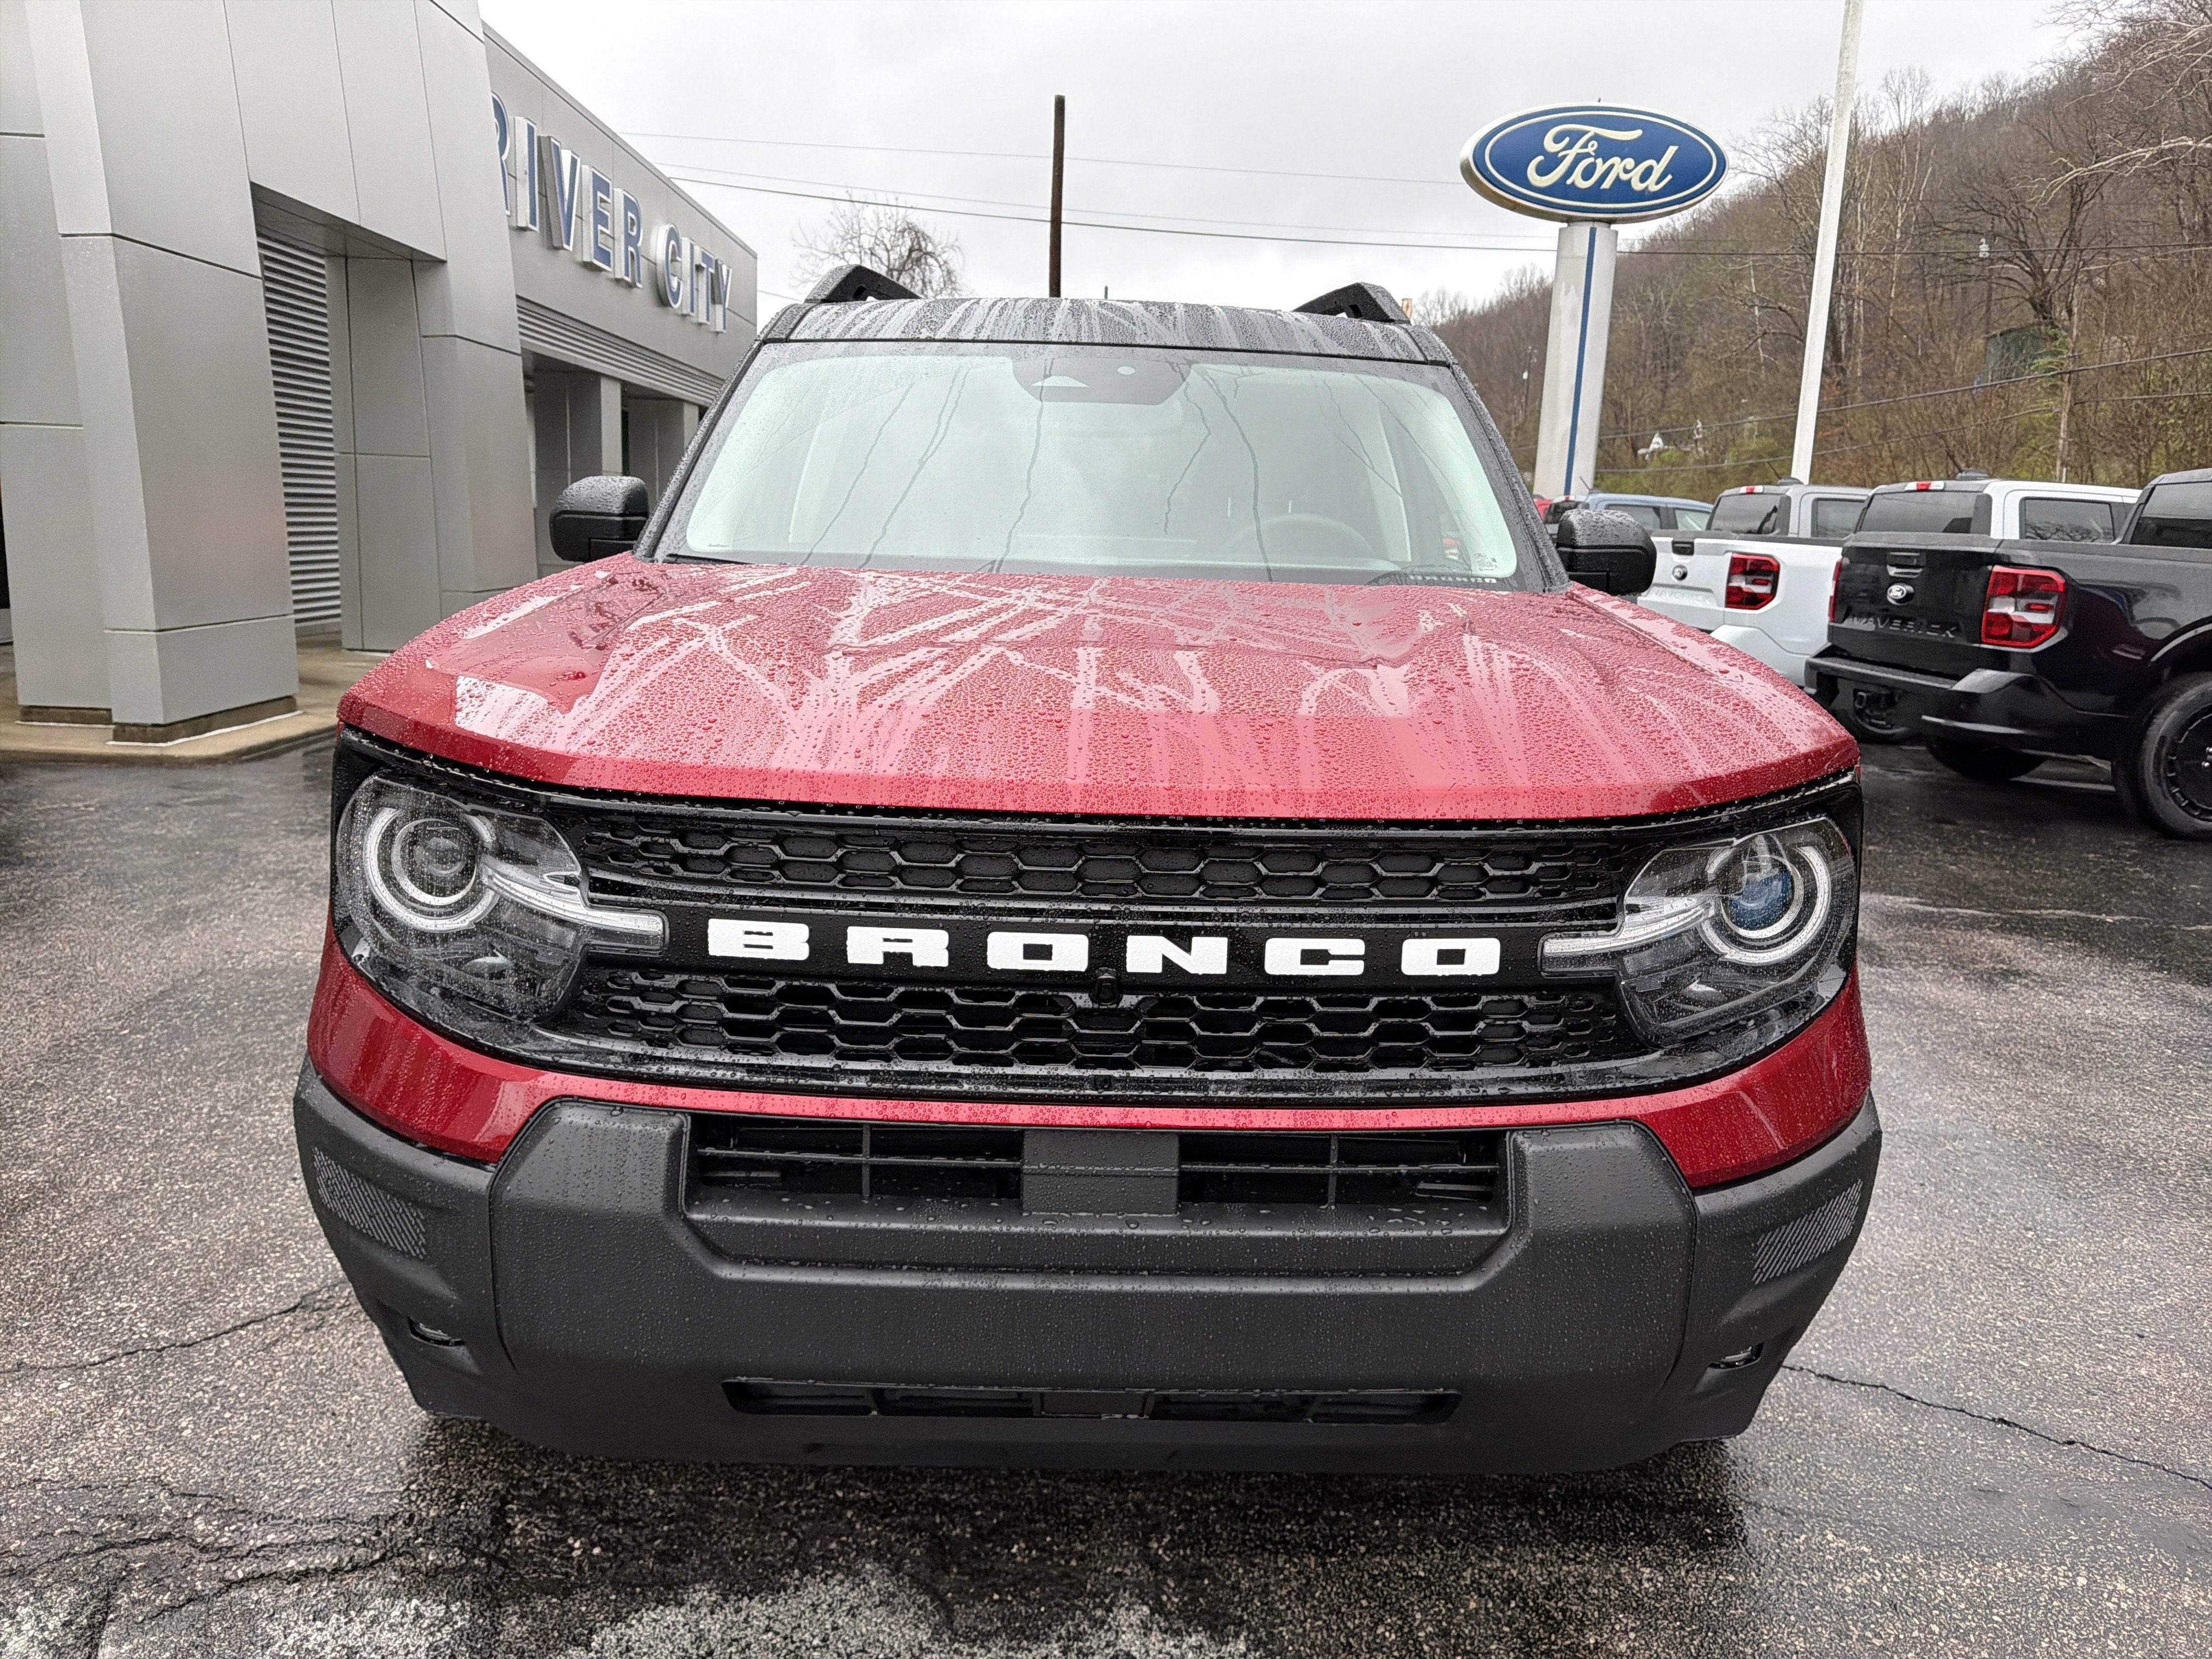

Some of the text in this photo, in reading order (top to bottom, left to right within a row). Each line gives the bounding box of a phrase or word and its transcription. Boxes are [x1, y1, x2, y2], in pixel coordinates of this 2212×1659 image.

[1527, 123, 1679, 191] Ford
[491, 91, 732, 332] RIVER CITY
[708, 918, 1501, 975] BRONCO
